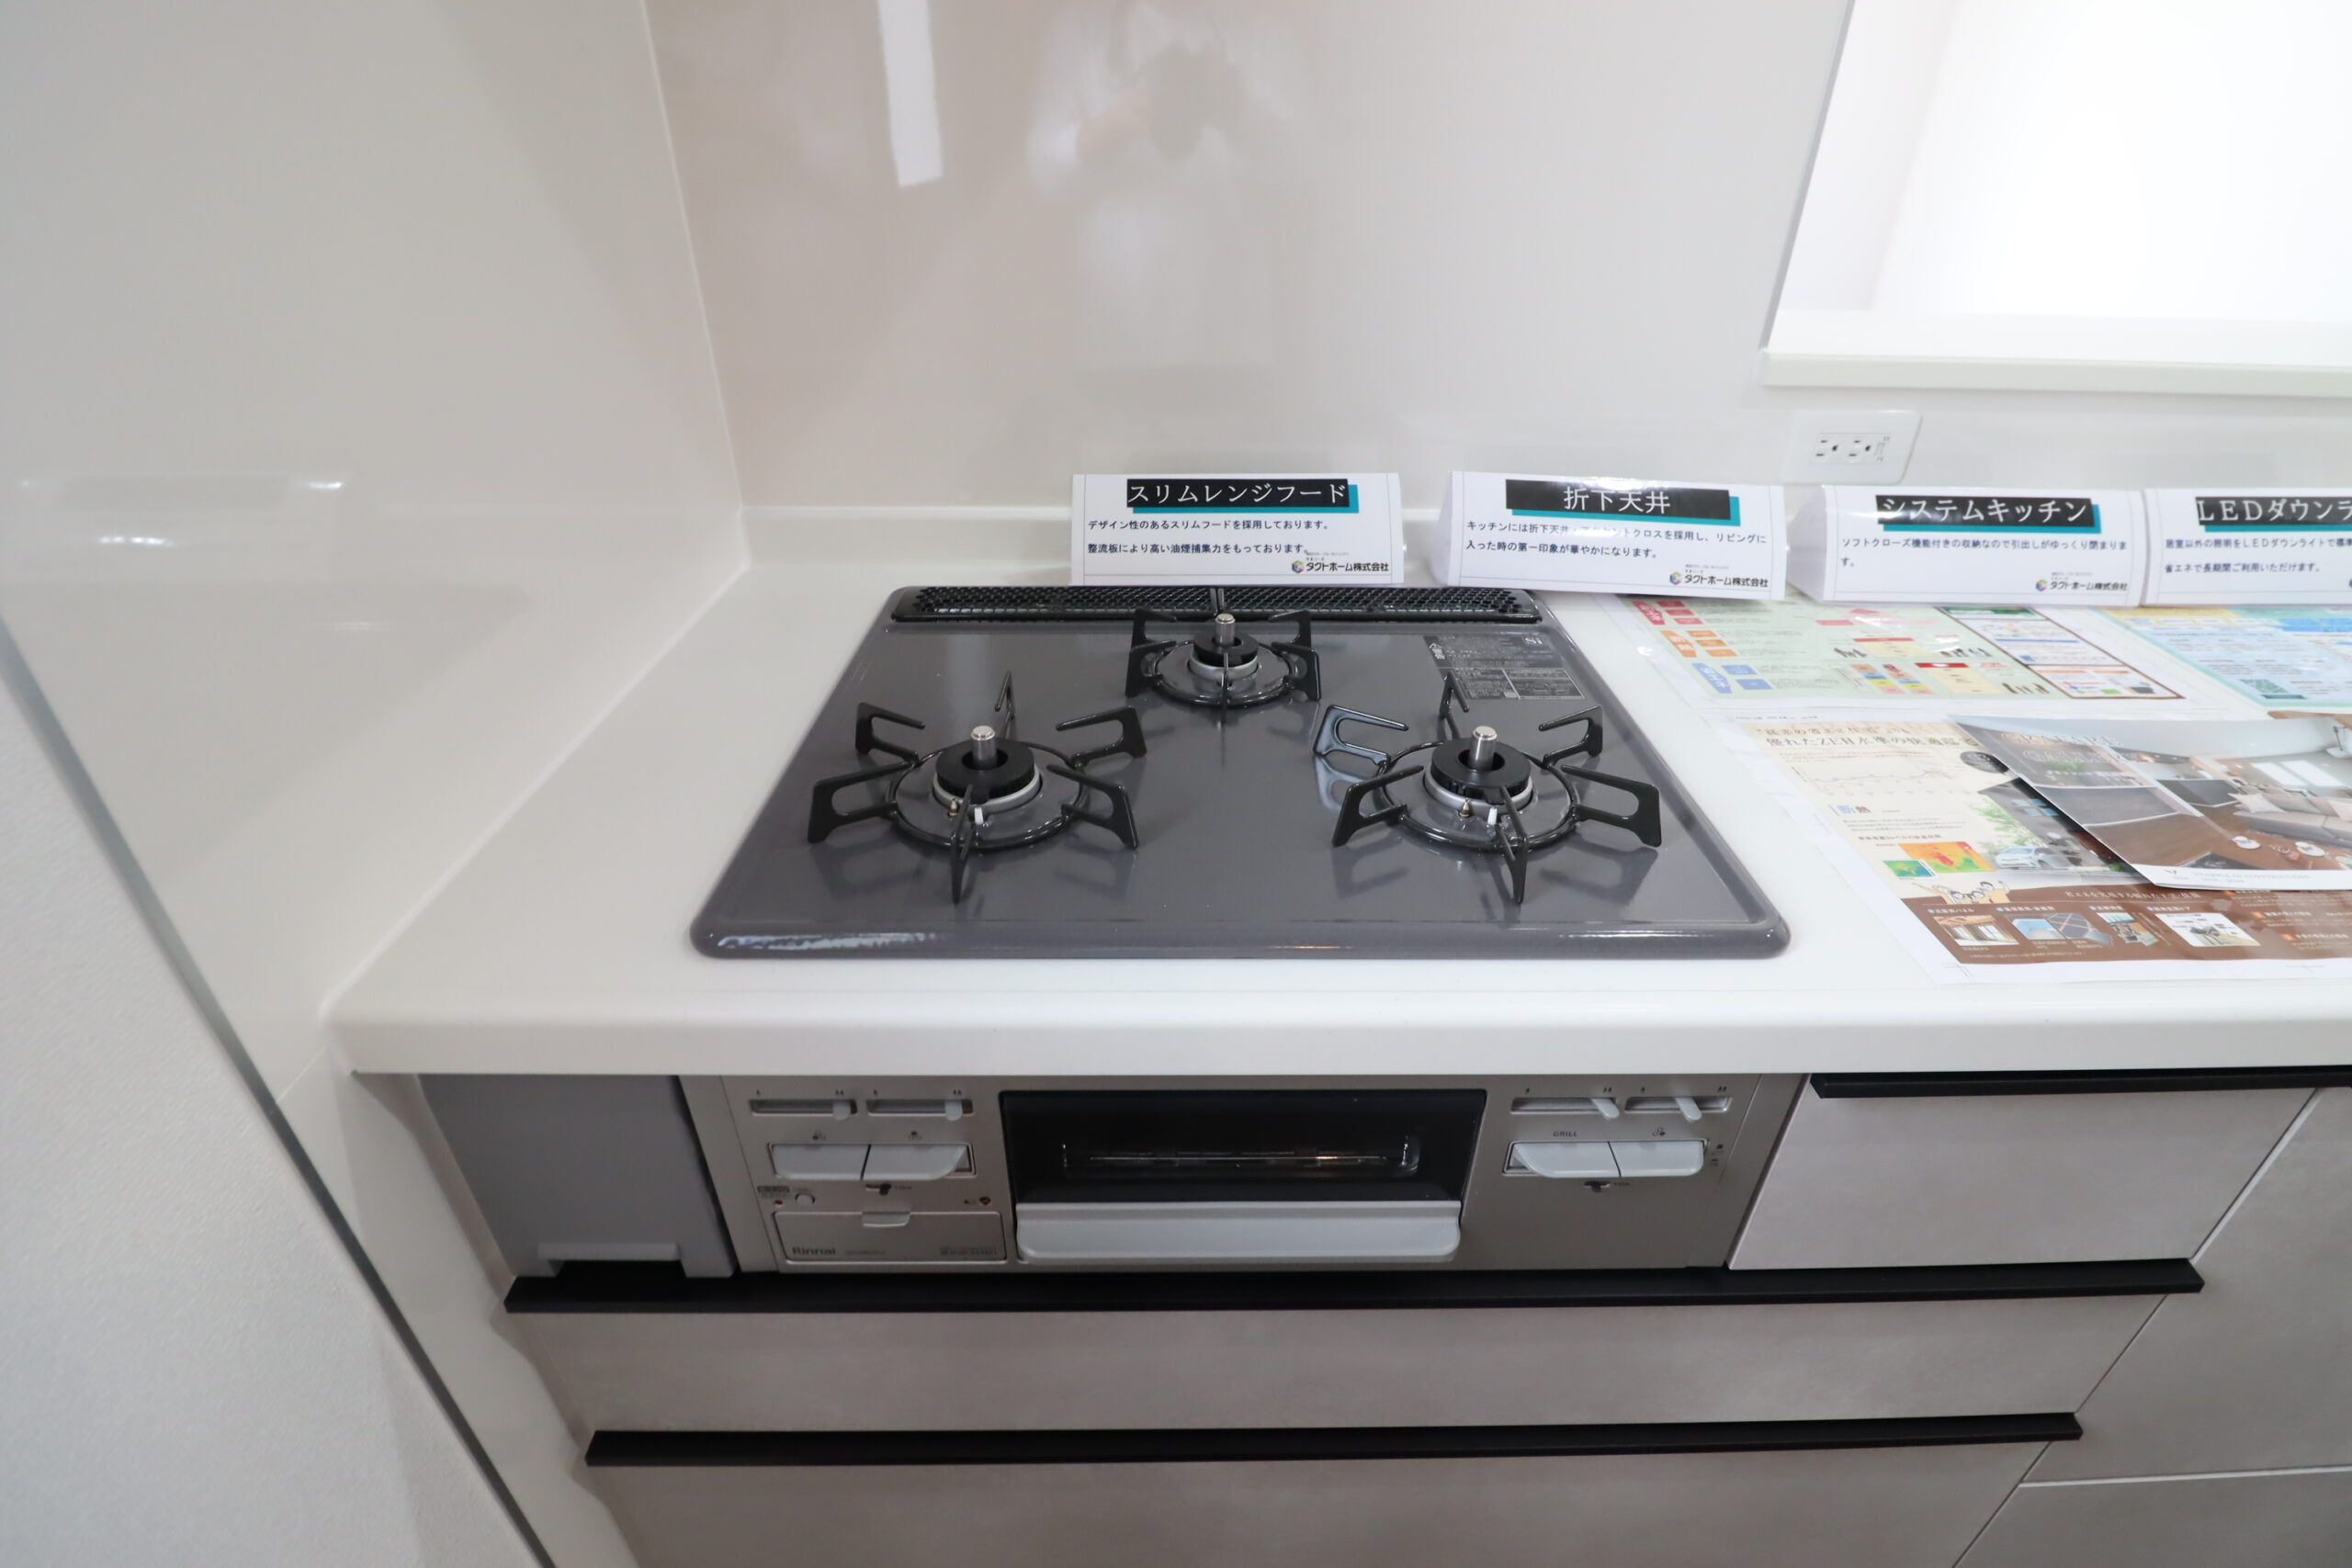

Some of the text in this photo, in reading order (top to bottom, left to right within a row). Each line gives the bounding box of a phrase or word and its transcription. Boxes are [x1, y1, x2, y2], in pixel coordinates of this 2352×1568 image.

[1127, 482, 1347, 504] スリムレンジフード
[1563, 487, 1671, 514] 折下天井
[1882, 499, 2088, 524] システムキッチン
[1087, 519, 1330, 531] デザイン性のあるスリムフードを採用しております。
[1087, 542, 1309, 555] 整流板により高い油煙捕集力をもっております。
[1465, 539, 1657, 558] 入った時の第一印象が華やかになります。
[1306, 561, 1389, 571] タクトホーム株式会社
[1684, 574, 1769, 589] タクトホーム株式会社
[791, 1247, 836, 1256] Rinnai
